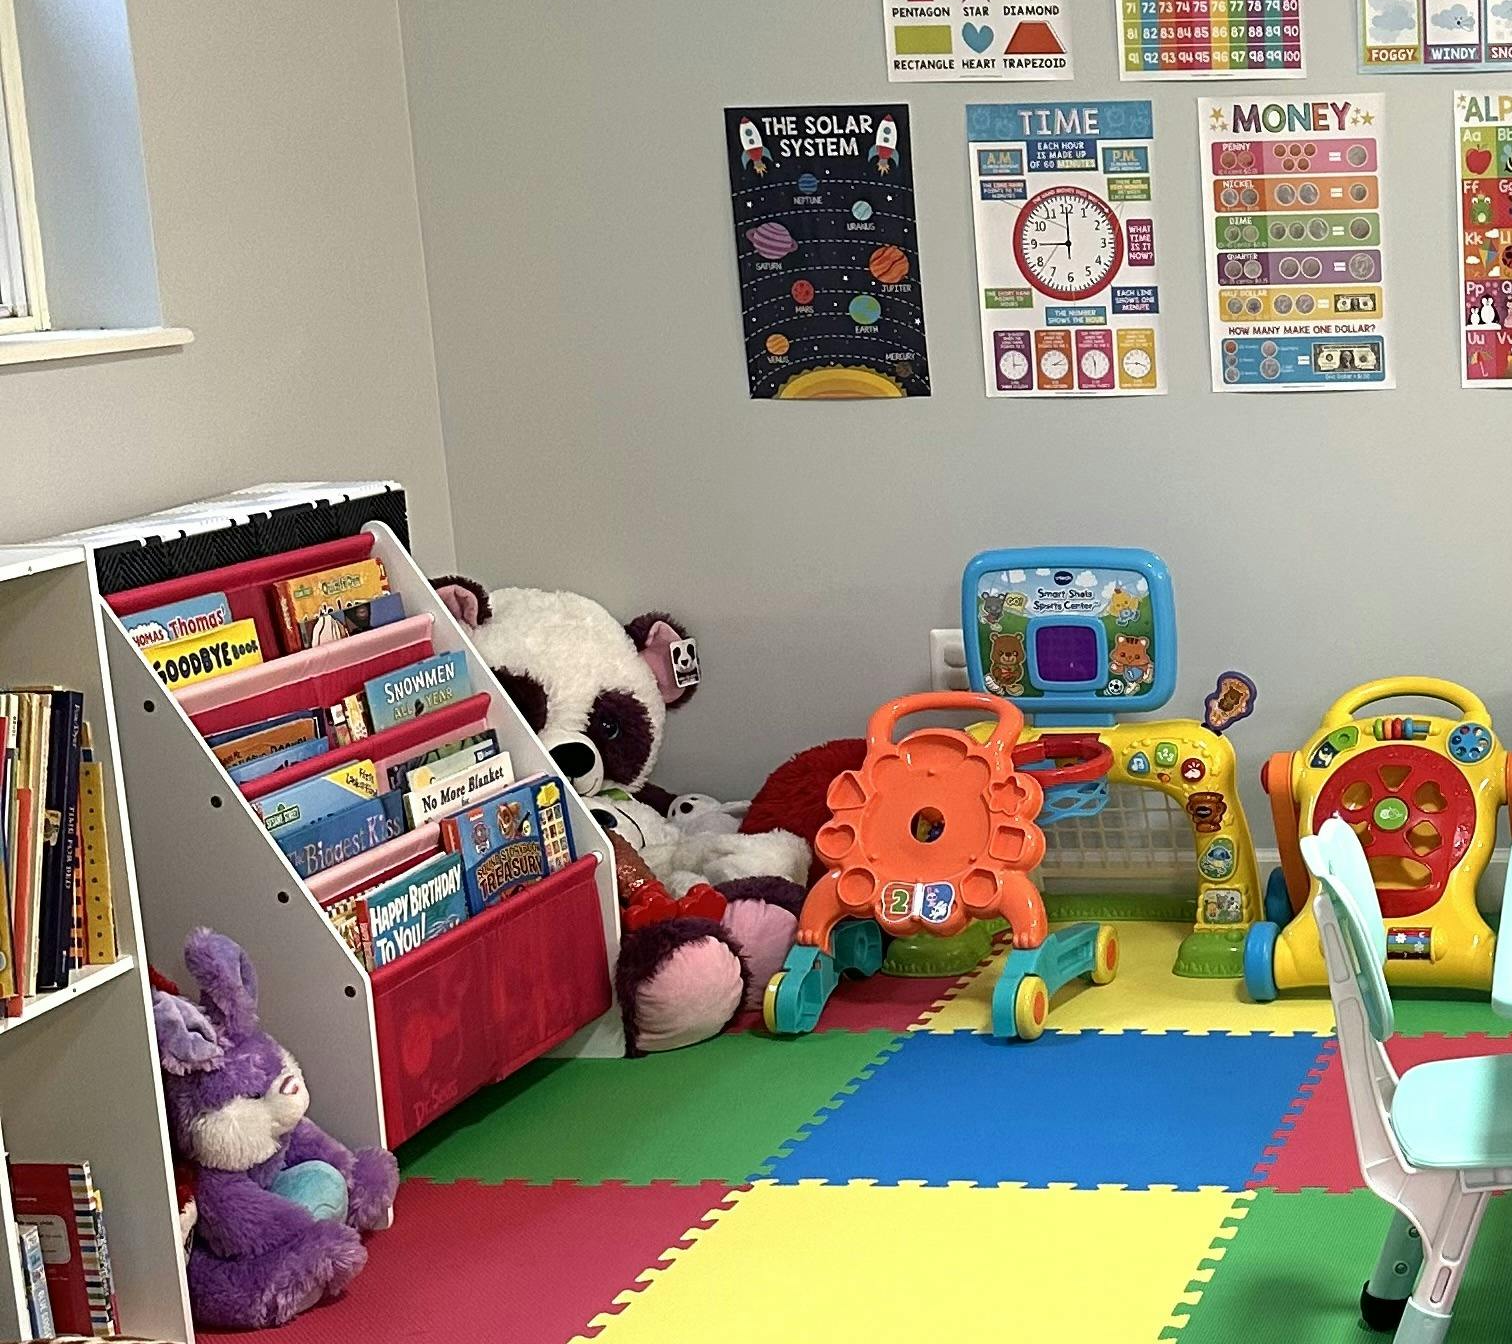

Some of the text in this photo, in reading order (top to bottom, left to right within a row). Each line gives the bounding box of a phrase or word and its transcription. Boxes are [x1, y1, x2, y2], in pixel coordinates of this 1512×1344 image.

[892, 6, 950, 18] PENTAGON
[1003, 4, 1060, 16] DIAMOND
[894, 57, 954, 70] RECTANGLE
[1002, 57, 1066, 69] TRAPEZOID
[1372, 49, 1415, 62] FOGGY
[762, 115, 873, 135] THE SOLAR
[1018, 108, 1100, 135] TIME
[1232, 101, 1351, 133] MONEY
[780, 138, 858, 156] SYSTEM
[1038, 142, 1058, 150] EACH
[1223, 143, 1250, 151] PENNY
[794, 197, 823, 205] NEPTUNE
[1229, 327, 1249, 335] HOW
[1284, 326, 1310, 334] MAKE
[1335, 324, 1375, 333] DOLLAR?
[1038, 588, 1065, 598] Smart
[1034, 601, 1062, 611] Sports
[132, 630, 164, 647] HOMAS
[384, 661, 455, 704] SNOWMEN
[425, 688, 452, 709] YEAR
[393, 703, 413, 720] ALL
[422, 767, 504, 813] No More Blanket
[367, 815, 400, 846] Kiss
[370, 864, 461, 937] HAPPY BIRTHDAY
[890, 889, 909, 914] 2
